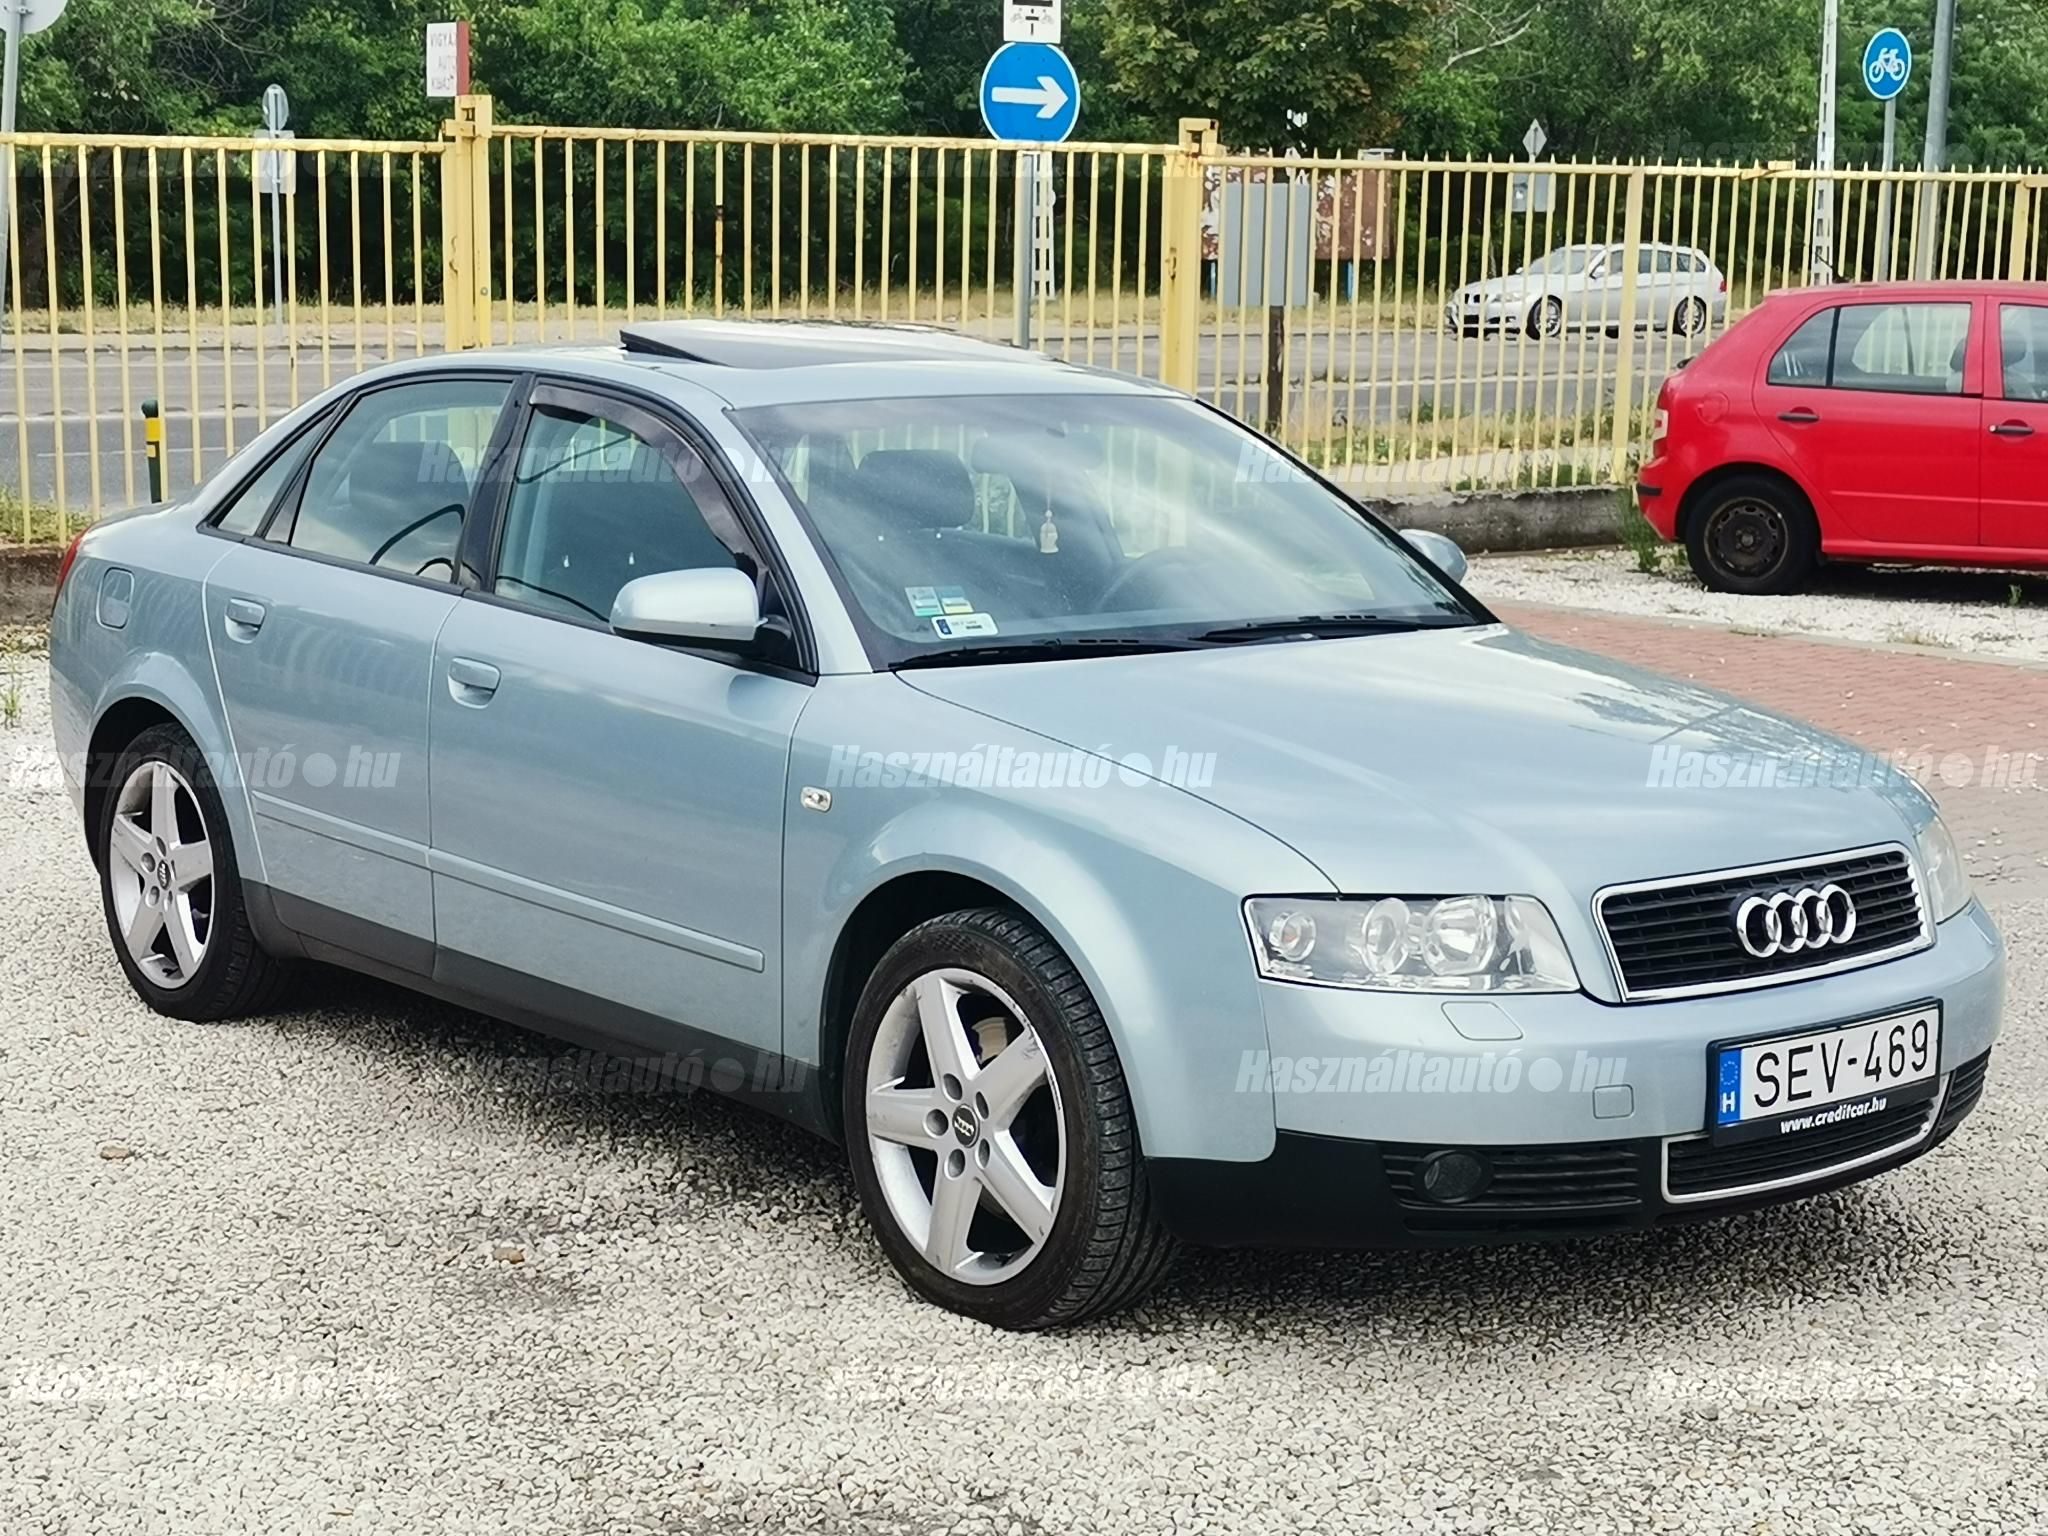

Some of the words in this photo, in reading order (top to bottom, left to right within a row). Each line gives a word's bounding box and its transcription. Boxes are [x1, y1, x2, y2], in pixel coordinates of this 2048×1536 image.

[1754, 1019, 1928, 1108] SEV-469
[1721, 1091, 1736, 1114] H
[1780, 1096, 1887, 1134] www.creditcar.hu
